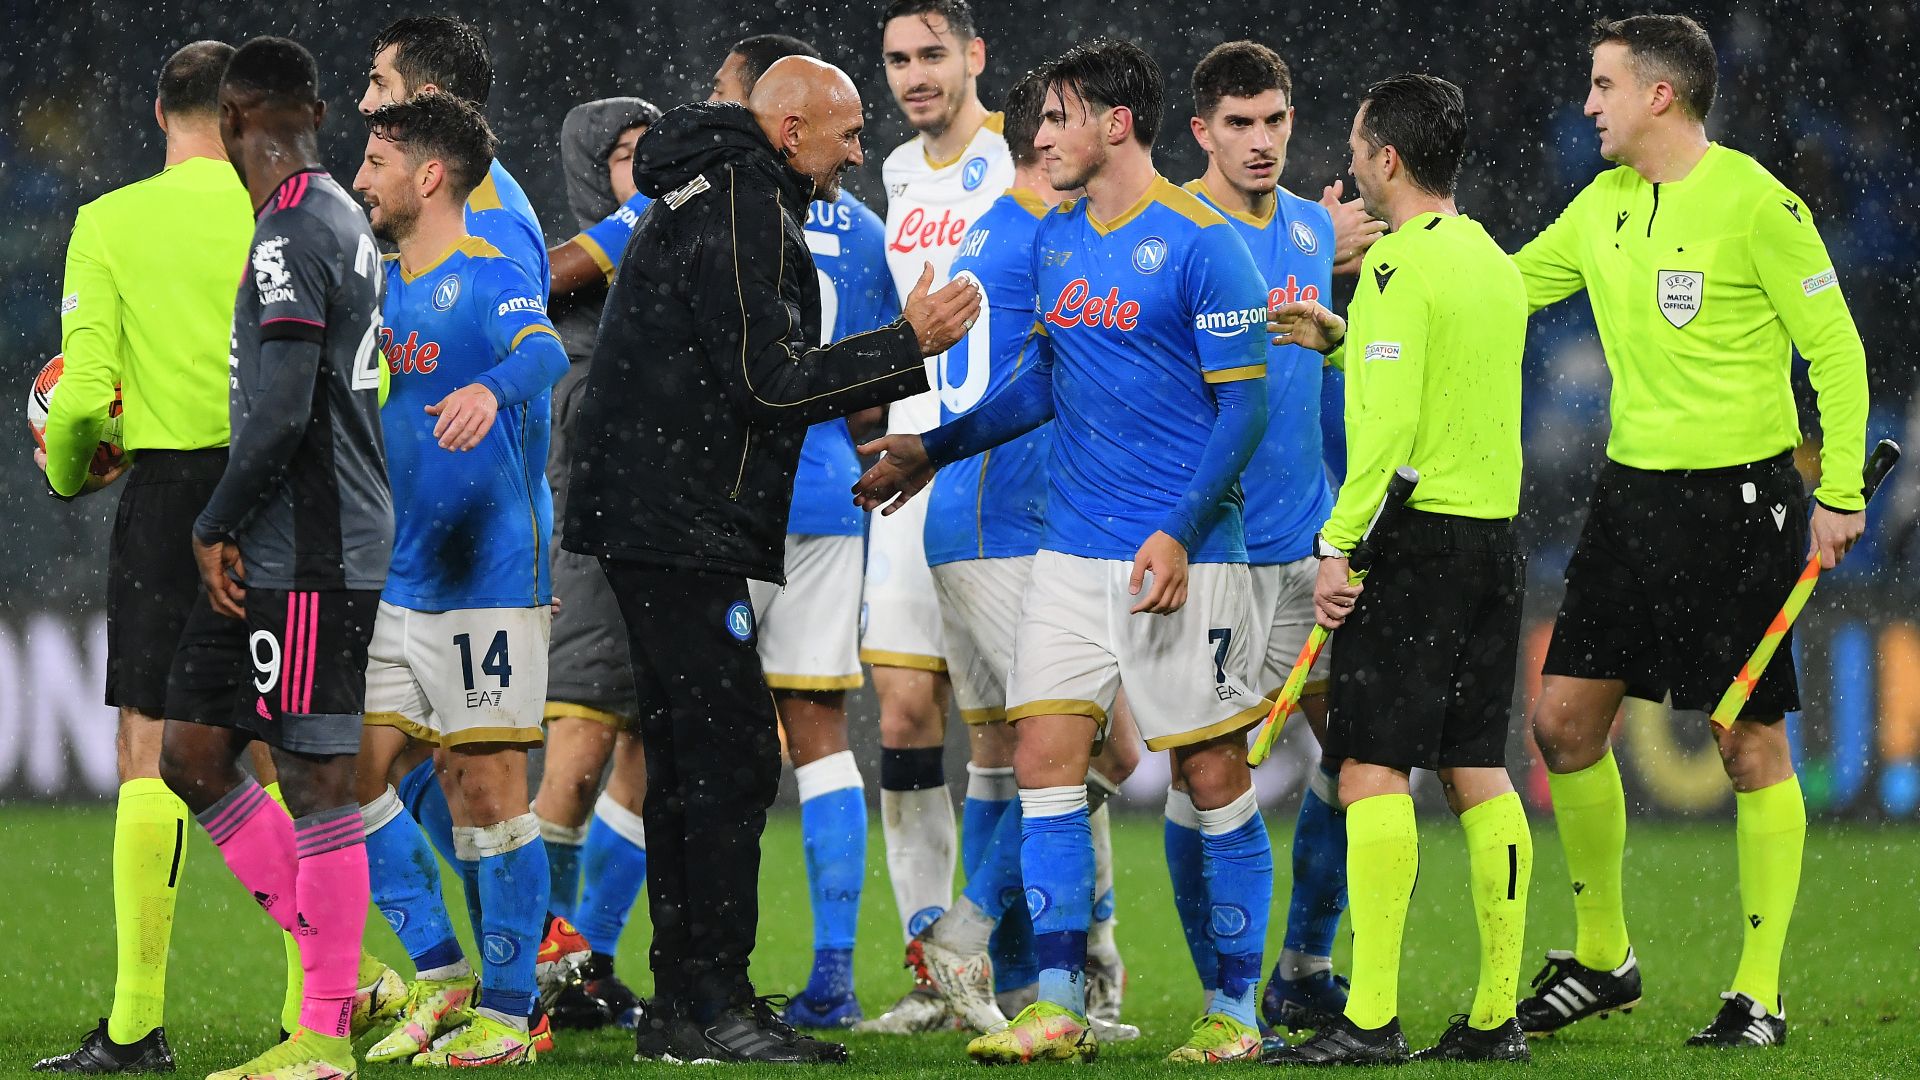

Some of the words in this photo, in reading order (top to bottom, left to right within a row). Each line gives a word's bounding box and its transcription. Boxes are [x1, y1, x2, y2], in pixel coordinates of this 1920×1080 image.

[889, 208, 965, 253] Lete
[1667, 276, 1693, 288] UEFA
[1045, 278, 1140, 331] Lete
[1663, 302, 1696, 311] OFFICIAL
[1667, 294, 1693, 302] MATCH
[1195, 306, 1267, 331] amazon
[249, 629, 281, 694] 9
[453, 630, 512, 691] 14
[1208, 628, 1232, 684] 7
[465, 690, 503, 709] EA7
[1215, 684, 1245, 701] EA
